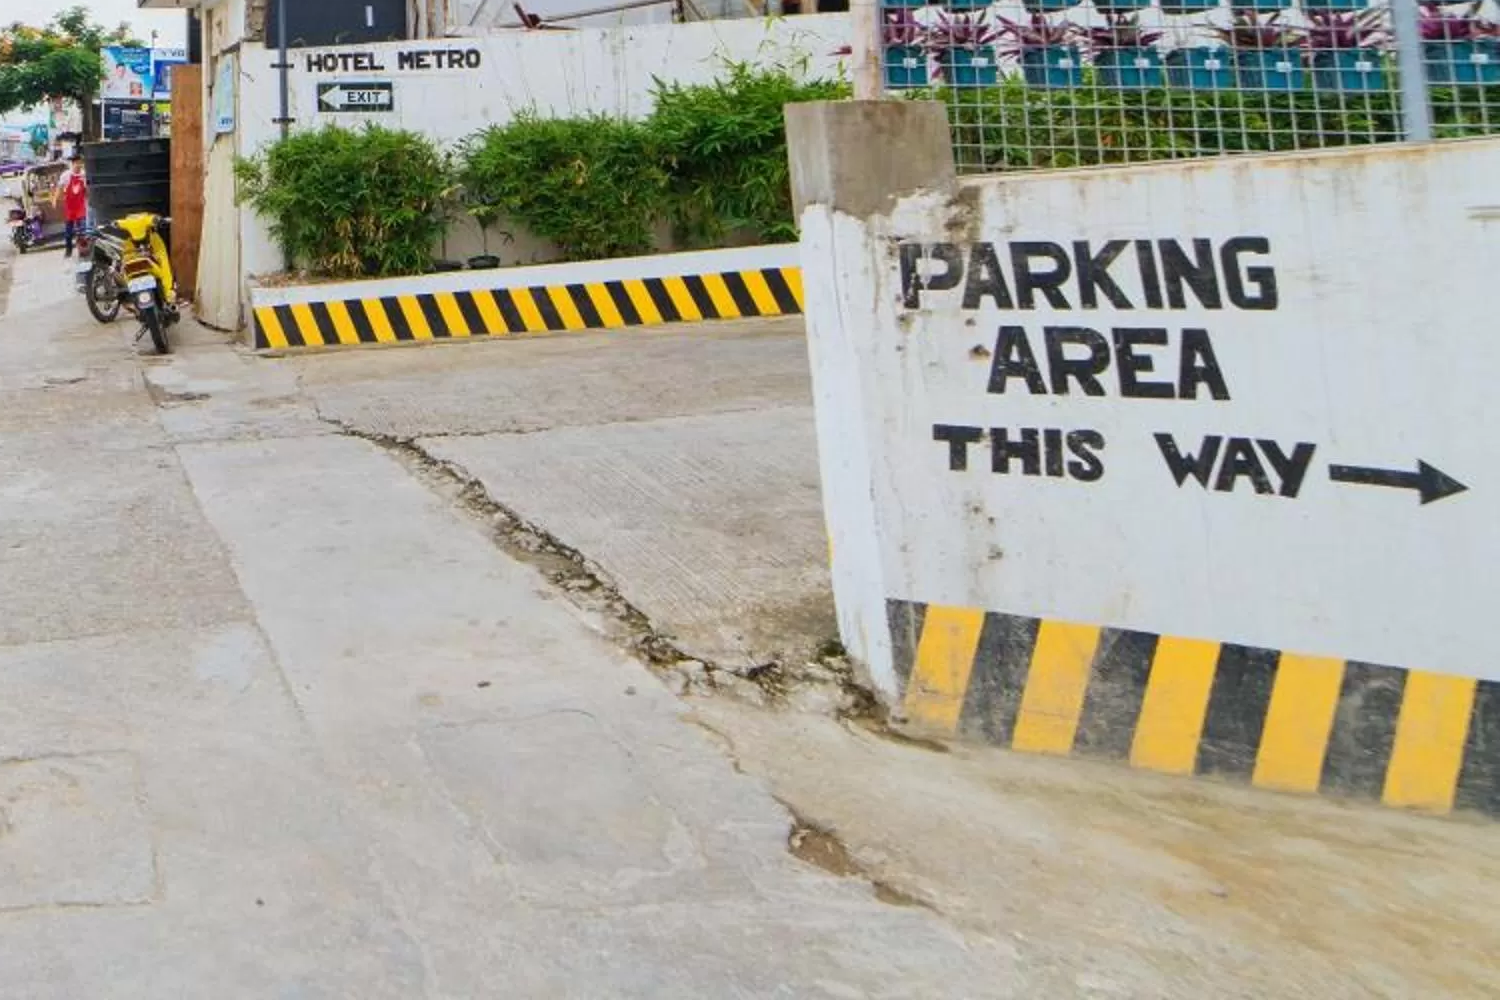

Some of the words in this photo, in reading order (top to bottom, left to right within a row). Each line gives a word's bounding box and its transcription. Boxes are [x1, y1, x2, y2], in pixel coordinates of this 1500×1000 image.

[306, 51, 385, 73] HOTEL
[397, 48, 481, 70] METRO
[347, 91, 381, 103] EXIT
[900, 236, 1279, 311] PARKING
[986, 324, 1231, 401] AREA
[932, 423, 1106, 483] THIS
[1153, 431, 1317, 499] WAY
